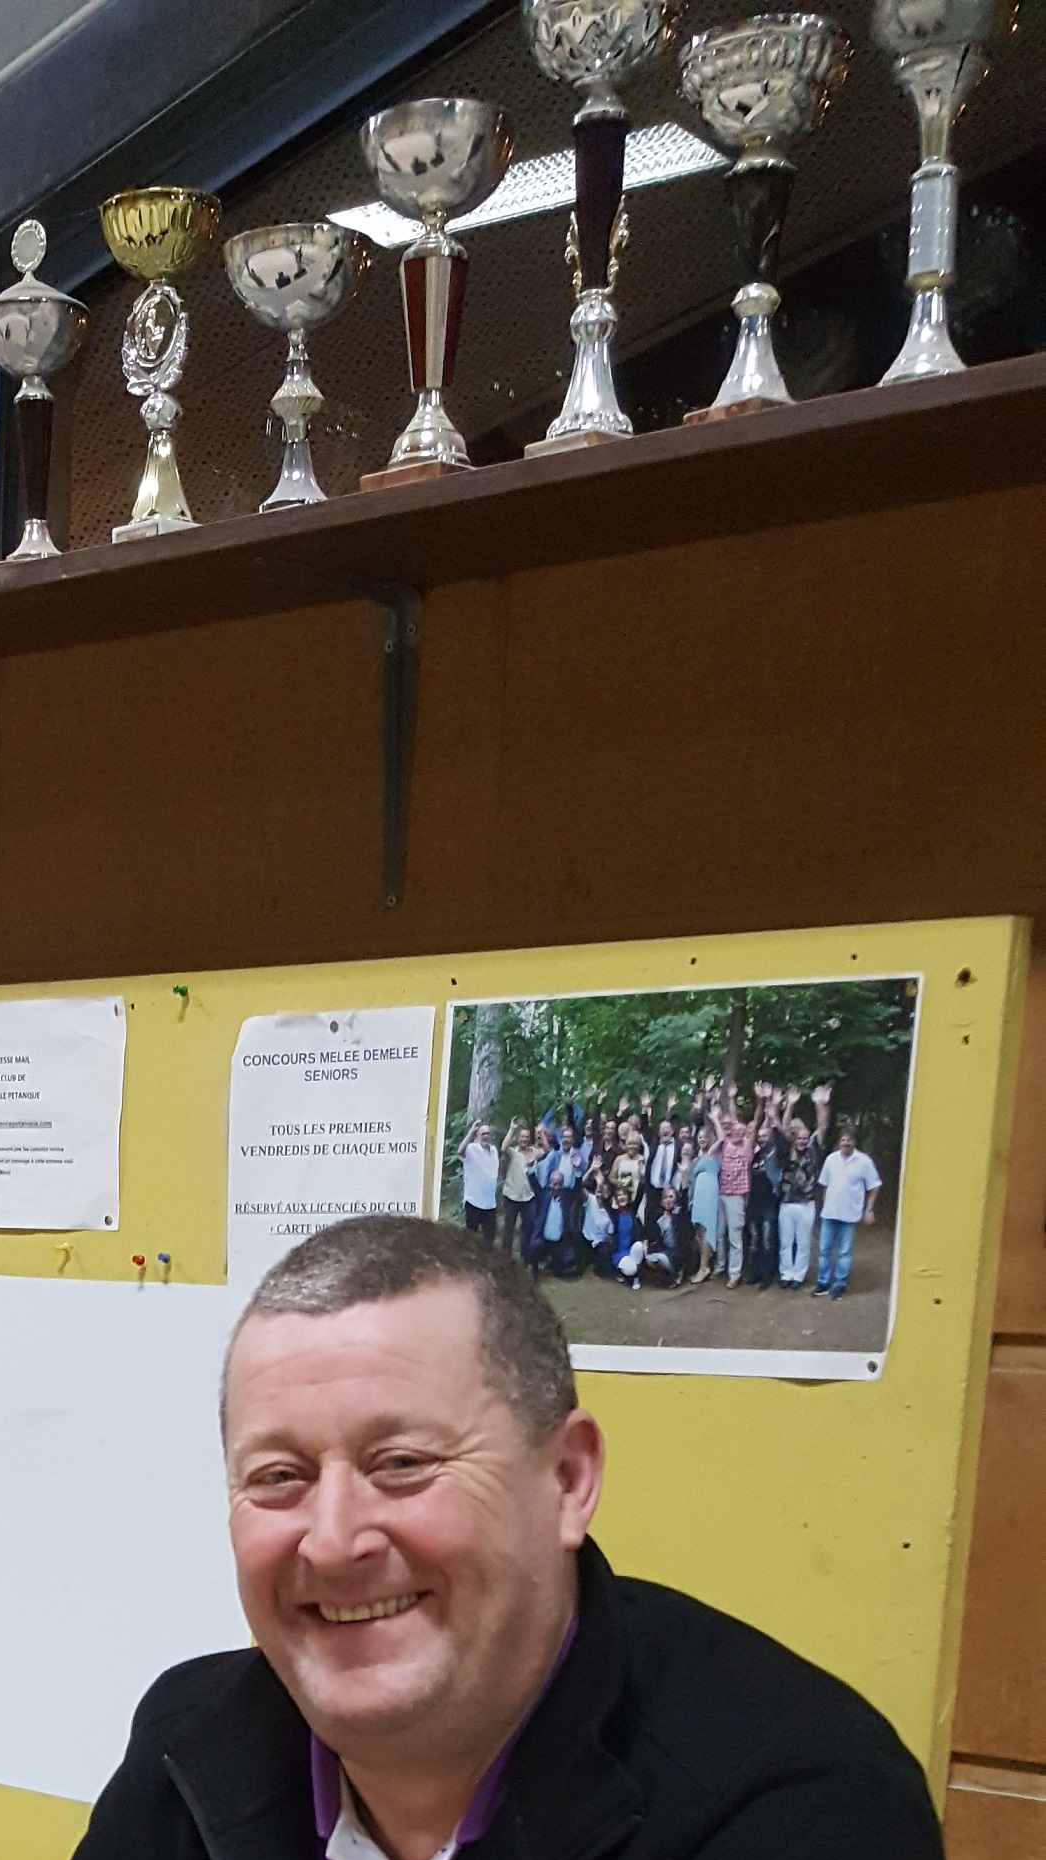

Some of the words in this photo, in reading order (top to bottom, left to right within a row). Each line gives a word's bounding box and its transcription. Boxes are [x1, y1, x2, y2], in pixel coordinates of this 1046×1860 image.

[14, 1055, 31, 1064] MAIL
[243, 1052, 316, 1067] CONCOURS
[319, 1050, 360, 1064] MELEE
[363, 1046, 419, 1062] DEMELEE
[0, 1074, 17, 1082] CLUB
[17, 1073, 26, 1082] DE
[304, 1068, 359, 1082] SENIORS
[7, 1091, 41, 1100] PETANQUE
[269, 1124, 301, 1136] TOUS
[303, 1123, 326, 1135] LES
[328, 1121, 392, 1135] PREMIERS
[240, 1144, 310, 1158] VENDREDIS
[313, 1143, 330, 1156] DE
[332, 1142, 385, 1157] CHAQUE
[388, 1141, 418, 1155] MOIS
[234, 1200, 283, 1213] RÉSERVÉ
[284, 1202, 308, 1213] AUX
[369, 1202, 385, 1212] DU
[387, 1201, 417, 1212] CLUB
[276, 1224, 312, 1235] CARTE
